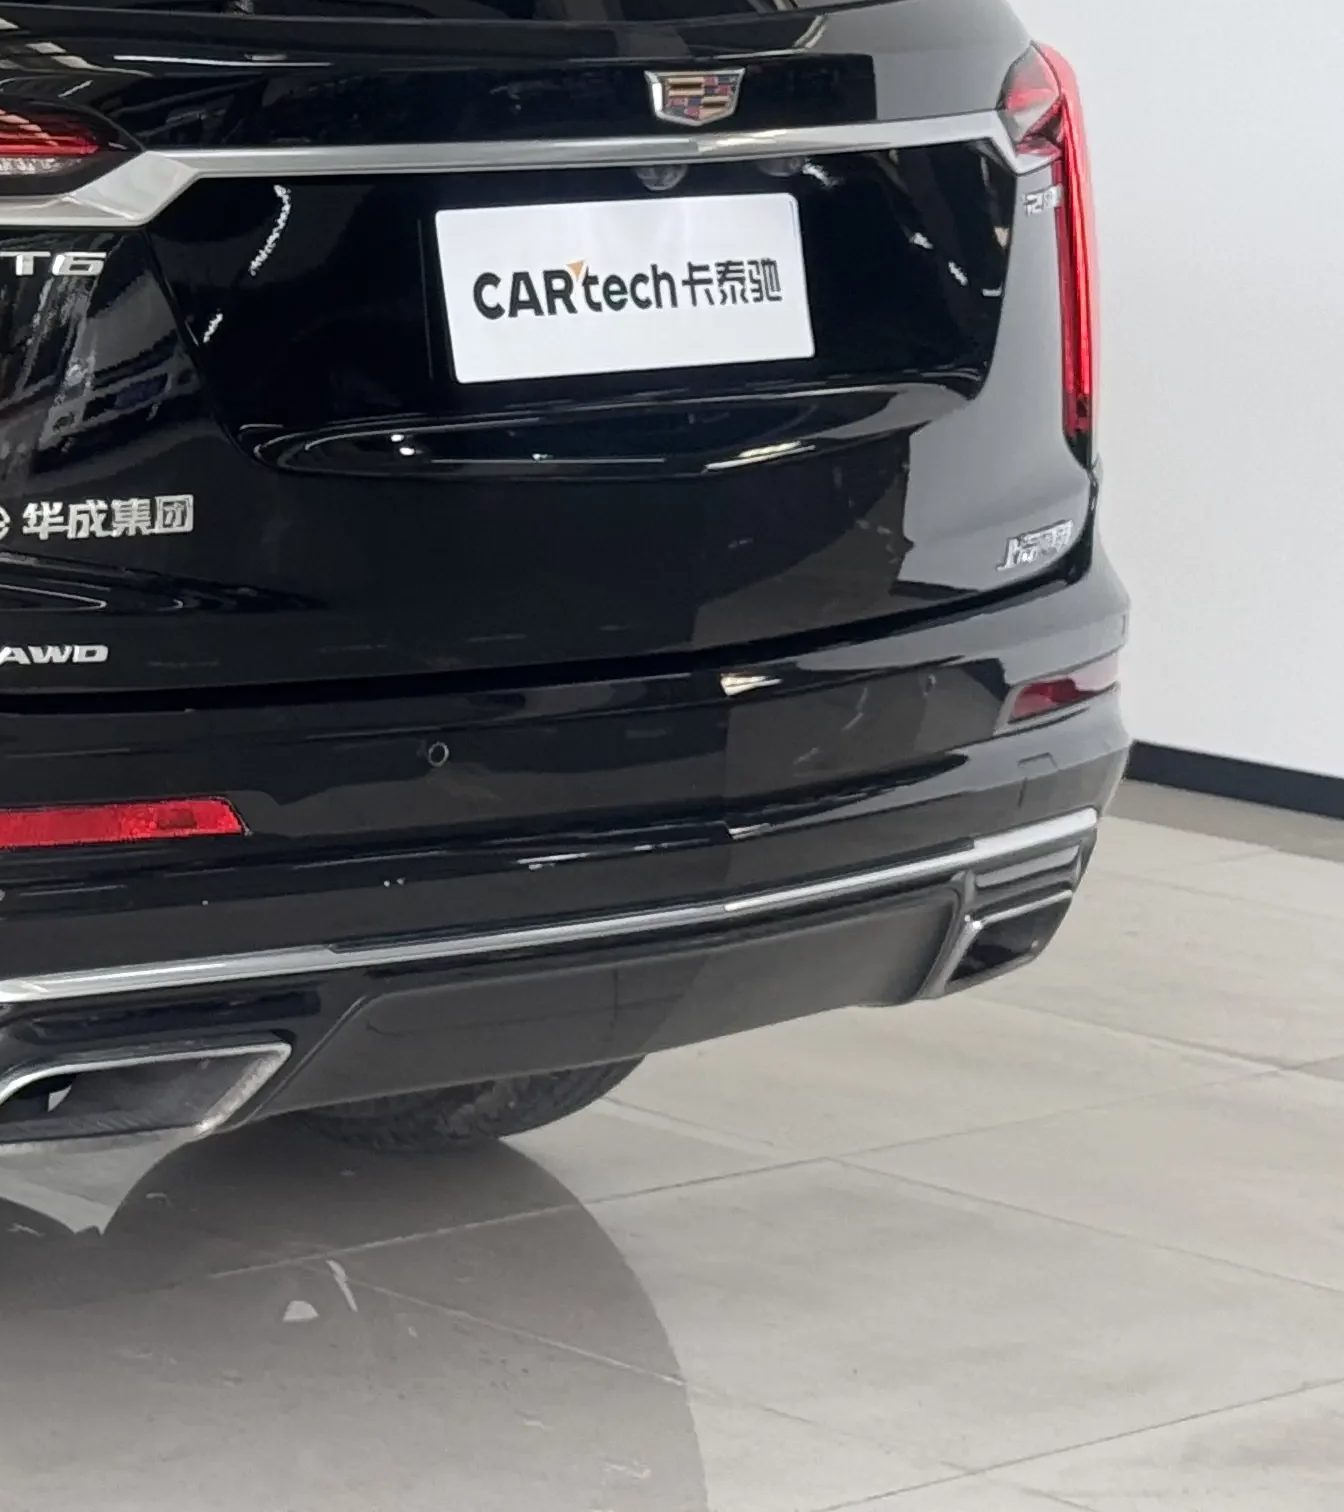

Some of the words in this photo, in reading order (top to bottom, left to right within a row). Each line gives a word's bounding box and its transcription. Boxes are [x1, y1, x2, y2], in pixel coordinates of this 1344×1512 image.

[473, 261, 678, 320] CARtech
[682, 258, 783, 307] 卡泰驰
[22, 494, 194, 541] 华成集团
